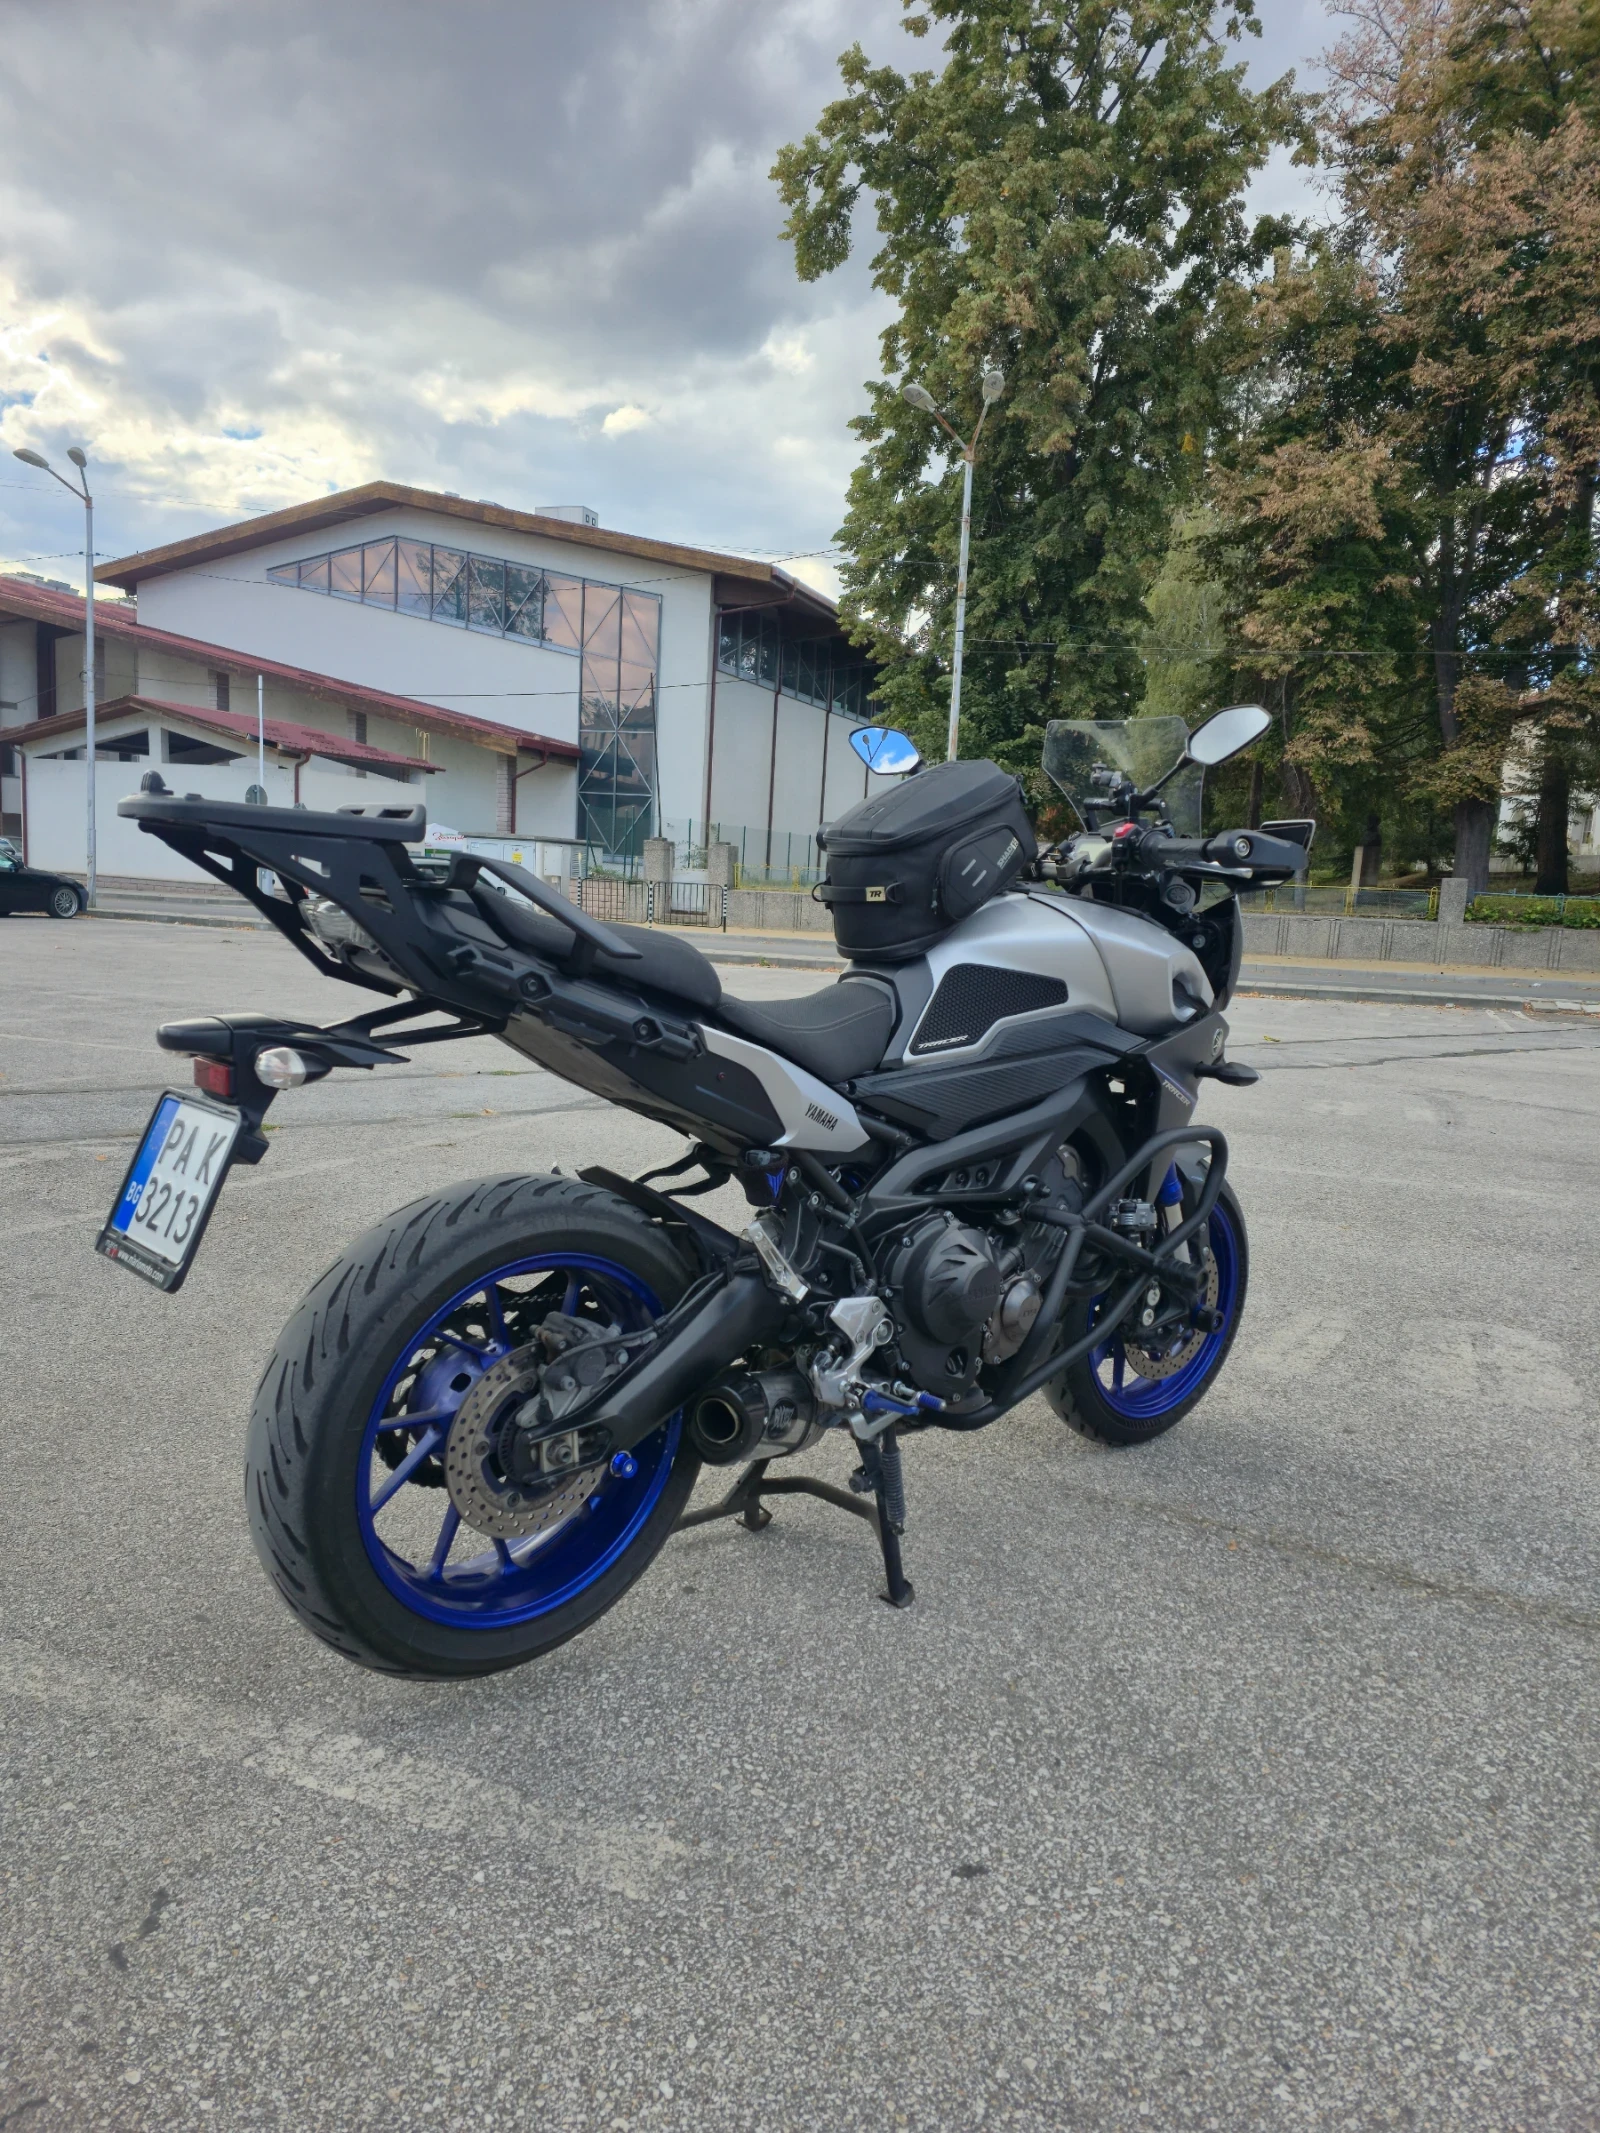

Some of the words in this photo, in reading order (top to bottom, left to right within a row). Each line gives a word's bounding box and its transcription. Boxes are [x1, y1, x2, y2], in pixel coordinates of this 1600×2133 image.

[997, 846, 1013, 868] SHAD
[869, 890, 882, 898] TR
[1161, 1079, 1191, 1107] TRACER
[805, 1103, 839, 1131] YAMAHA
[126, 1181, 143, 1205] BG
[135, 1177, 200, 1244] 3213
